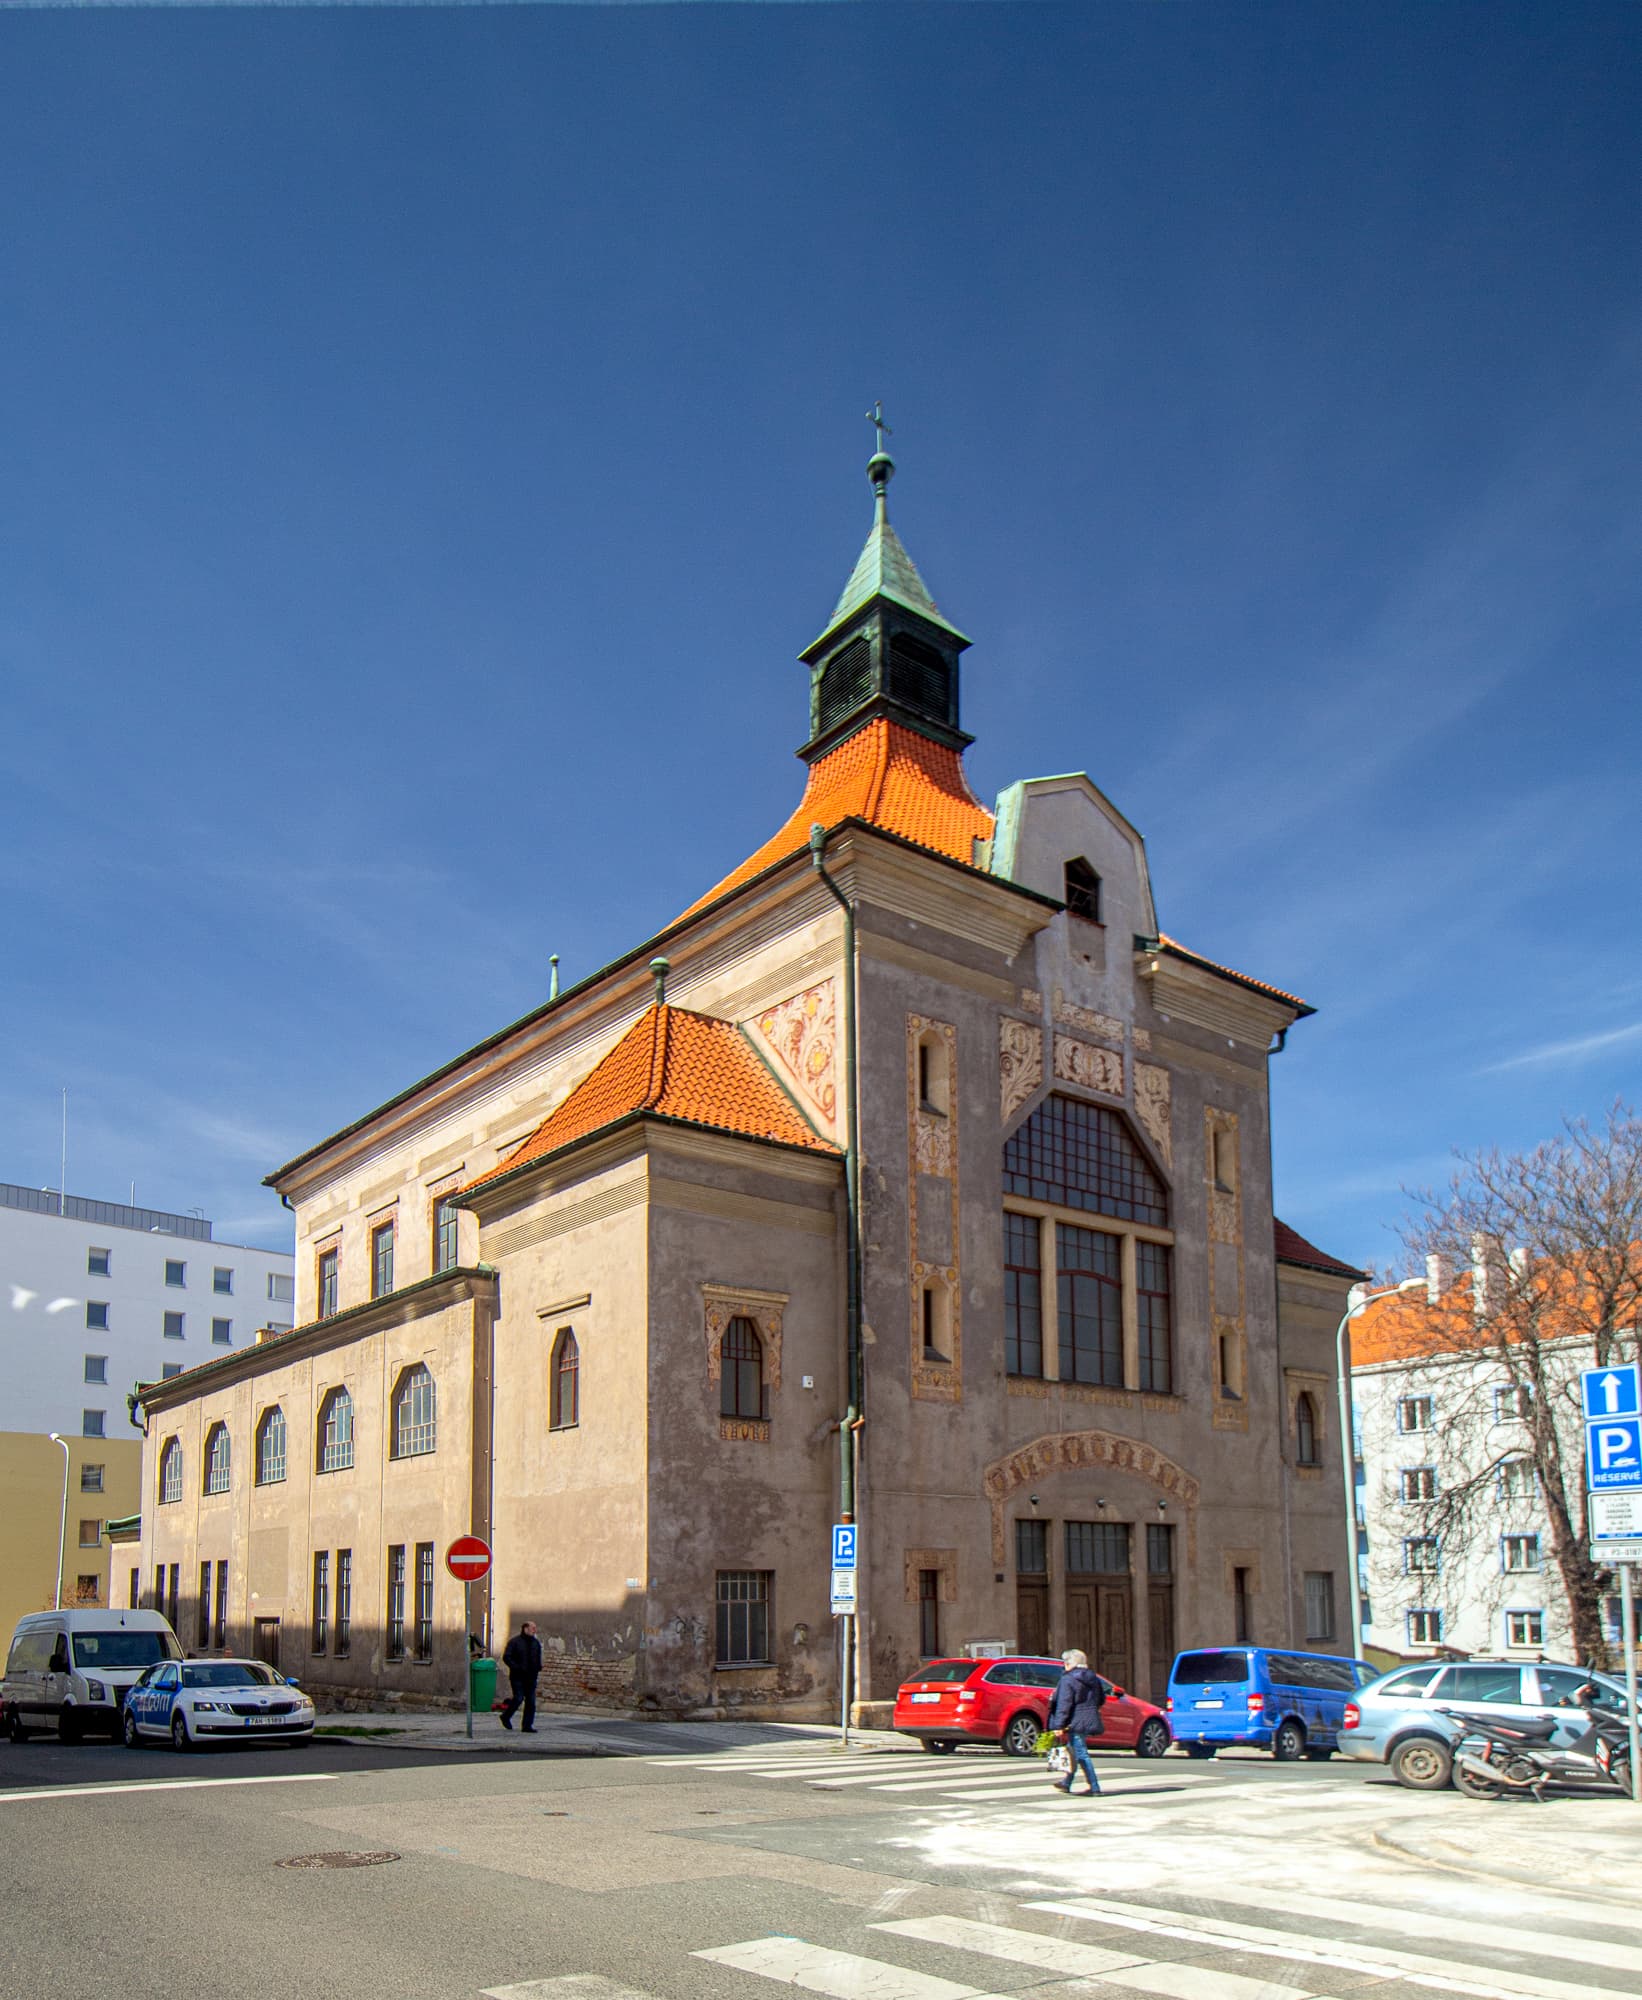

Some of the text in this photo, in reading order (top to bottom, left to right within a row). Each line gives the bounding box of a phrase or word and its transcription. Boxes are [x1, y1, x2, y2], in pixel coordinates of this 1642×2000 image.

[1598, 1427, 1632, 1469] P
[1594, 1470, 1641, 1482] RÉSERVÉ
[838, 1530, 853, 1556] P
